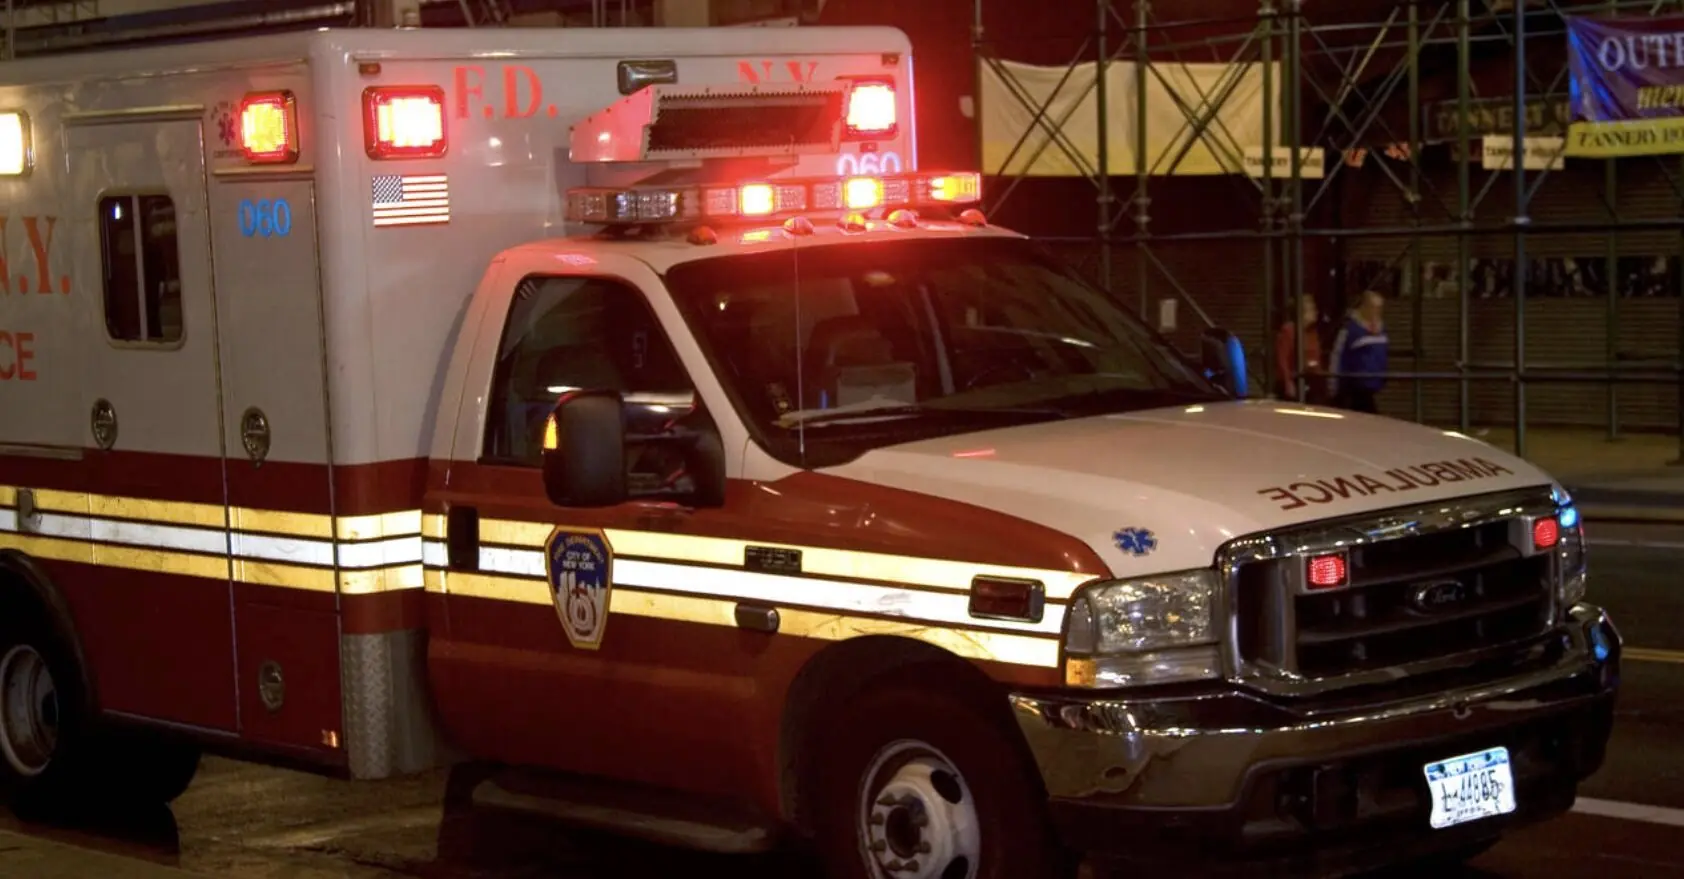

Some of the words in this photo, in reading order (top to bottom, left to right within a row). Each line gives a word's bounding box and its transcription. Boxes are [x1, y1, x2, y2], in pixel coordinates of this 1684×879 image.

[453, 64, 558, 119] F.D.
[836, 151, 901, 177] 060
[238, 197, 292, 238] 060
